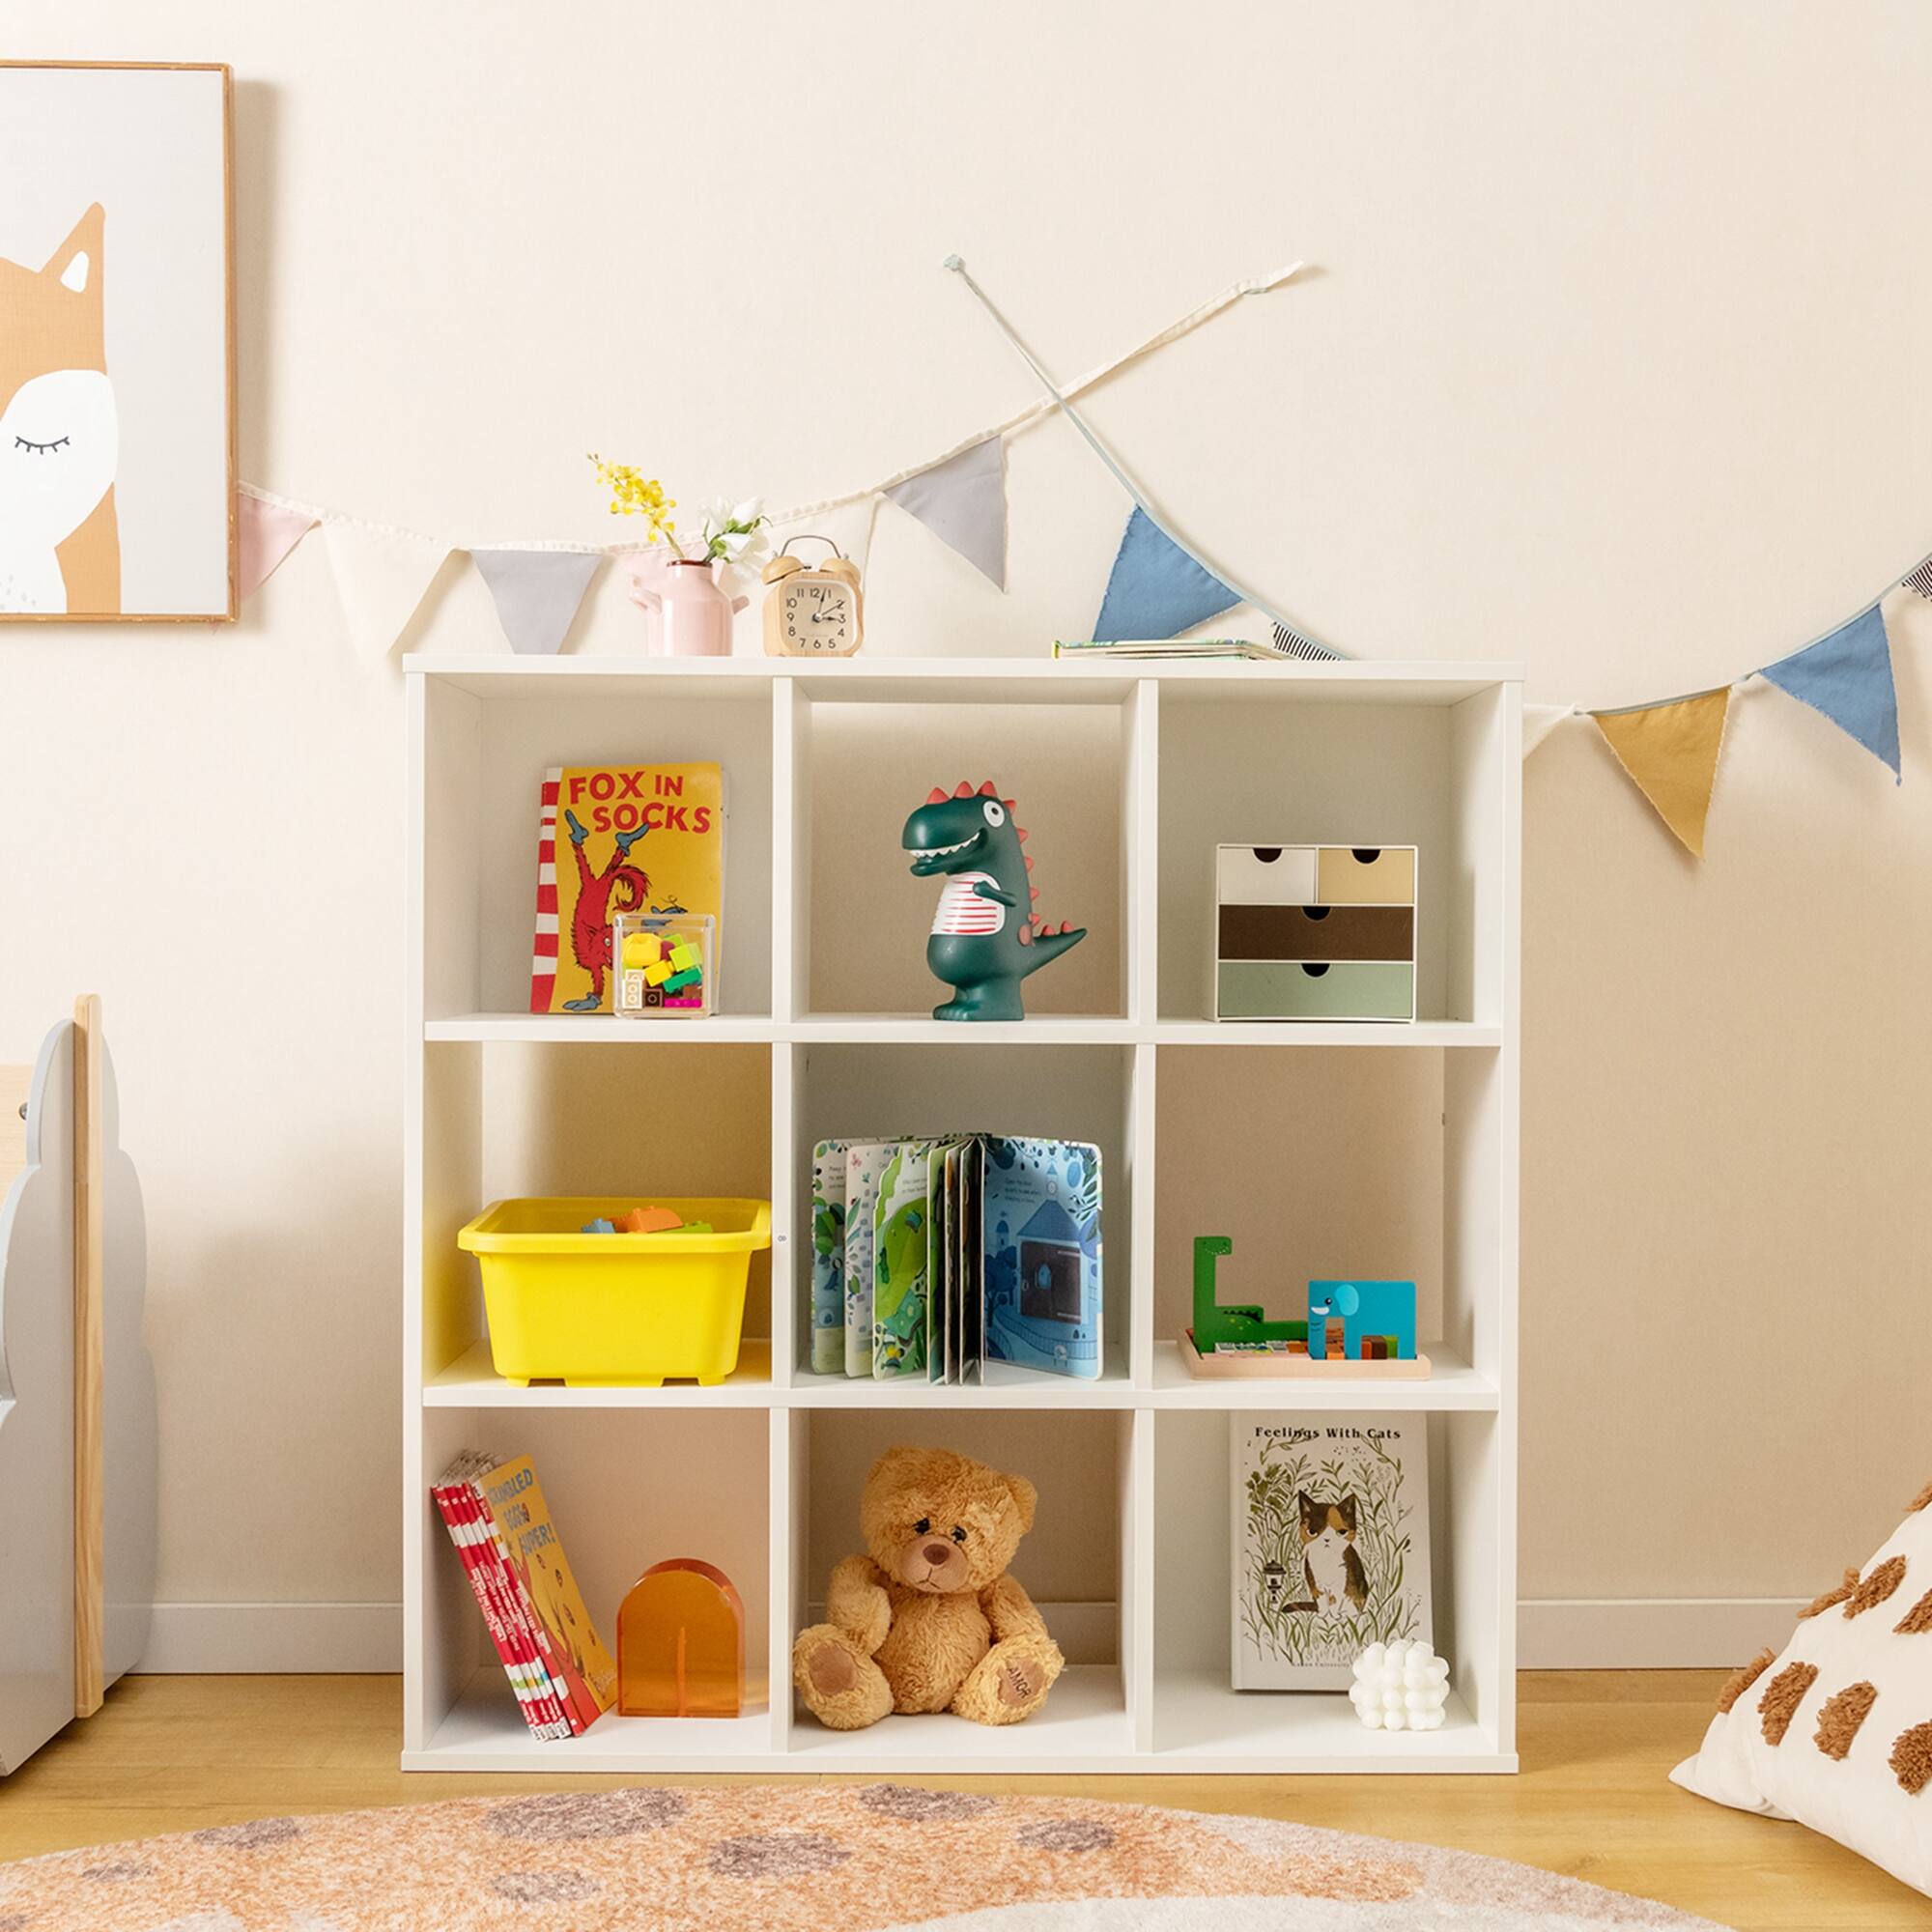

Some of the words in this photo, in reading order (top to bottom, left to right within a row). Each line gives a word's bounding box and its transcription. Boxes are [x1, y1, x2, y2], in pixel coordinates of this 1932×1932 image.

[797, 588, 805, 598] 11
[810, 587, 820, 598] 12
[786, 598, 798, 609] 10
[837, 599, 845, 610] 2
[786, 611, 794, 622] 9
[838, 613, 846, 624] 3
[788, 626, 796, 637] 8
[838, 628, 845, 638] 4
[799, 638, 807, 648] 7
[812, 639, 821, 649] 6
[828, 639, 836, 649] 5
[568, 771, 646, 805] FOX
[654, 774, 684, 797] IN
[592, 802, 712, 835] SOCKS
[1255, 1426, 1321, 1438] Feelings
[1325, 1427, 1361, 1438] With
[1367, 1428, 1402, 1439] Cats
[1007, 1666, 1031, 1699] AMOR
